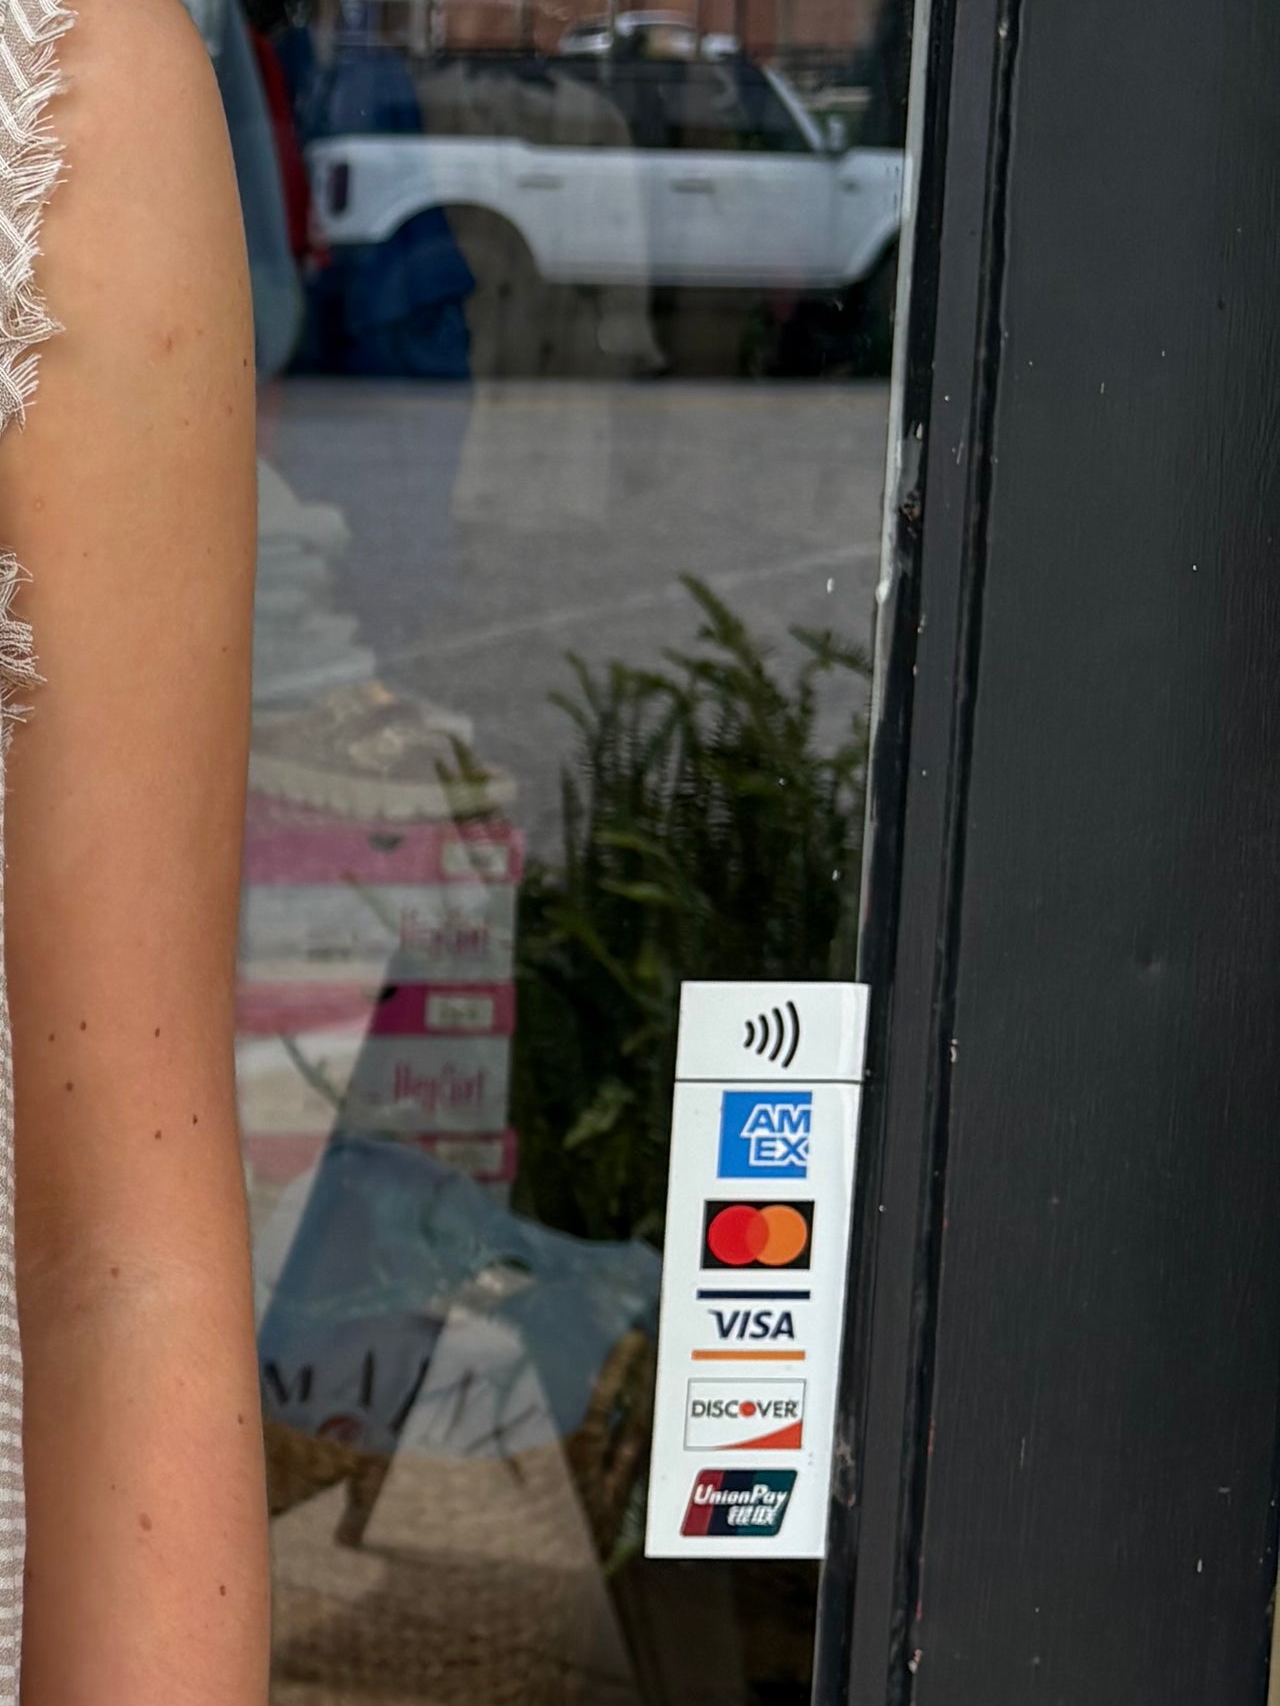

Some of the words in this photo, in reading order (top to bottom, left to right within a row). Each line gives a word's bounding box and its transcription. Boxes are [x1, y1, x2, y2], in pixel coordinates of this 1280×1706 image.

[740, 1103, 813, 1138] AM
[749, 1136, 810, 1166] EX
[708, 1309, 794, 1339] VISA
[690, 1398, 799, 1419] DISCOVER
[693, 1483, 788, 1511] UnionPay
